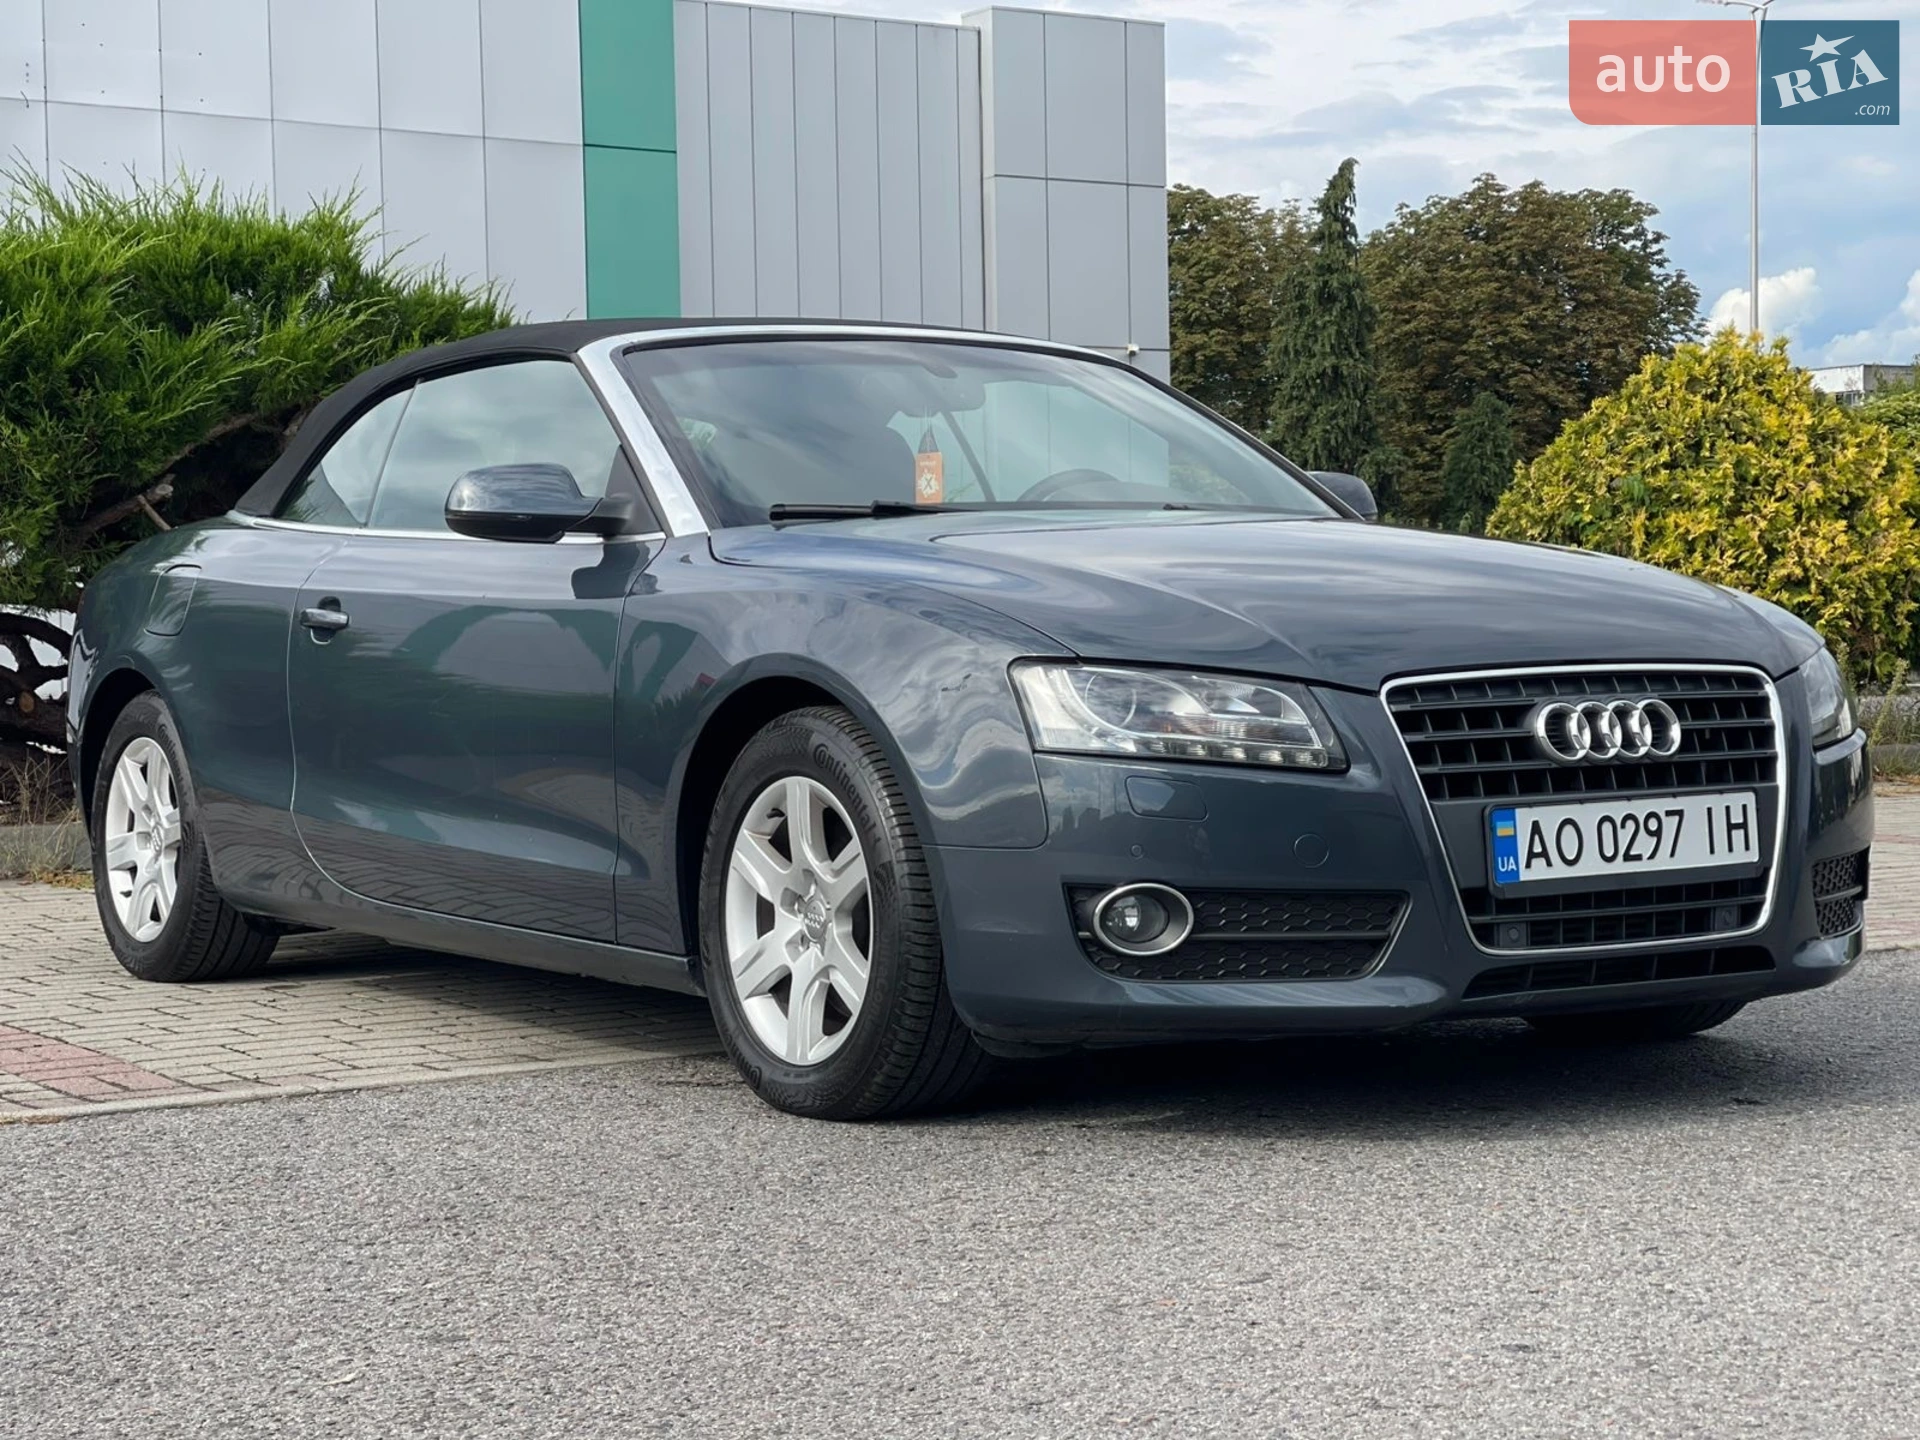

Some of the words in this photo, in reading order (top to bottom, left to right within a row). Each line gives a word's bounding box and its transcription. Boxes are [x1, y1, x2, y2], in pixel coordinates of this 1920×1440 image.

[813, 743, 877, 833] Continental
[1498, 856, 1518, 873] UA
[1524, 819, 1583, 870] AO
[1596, 810, 1685, 864] 0297
[1706, 803, 1751, 855] IH
